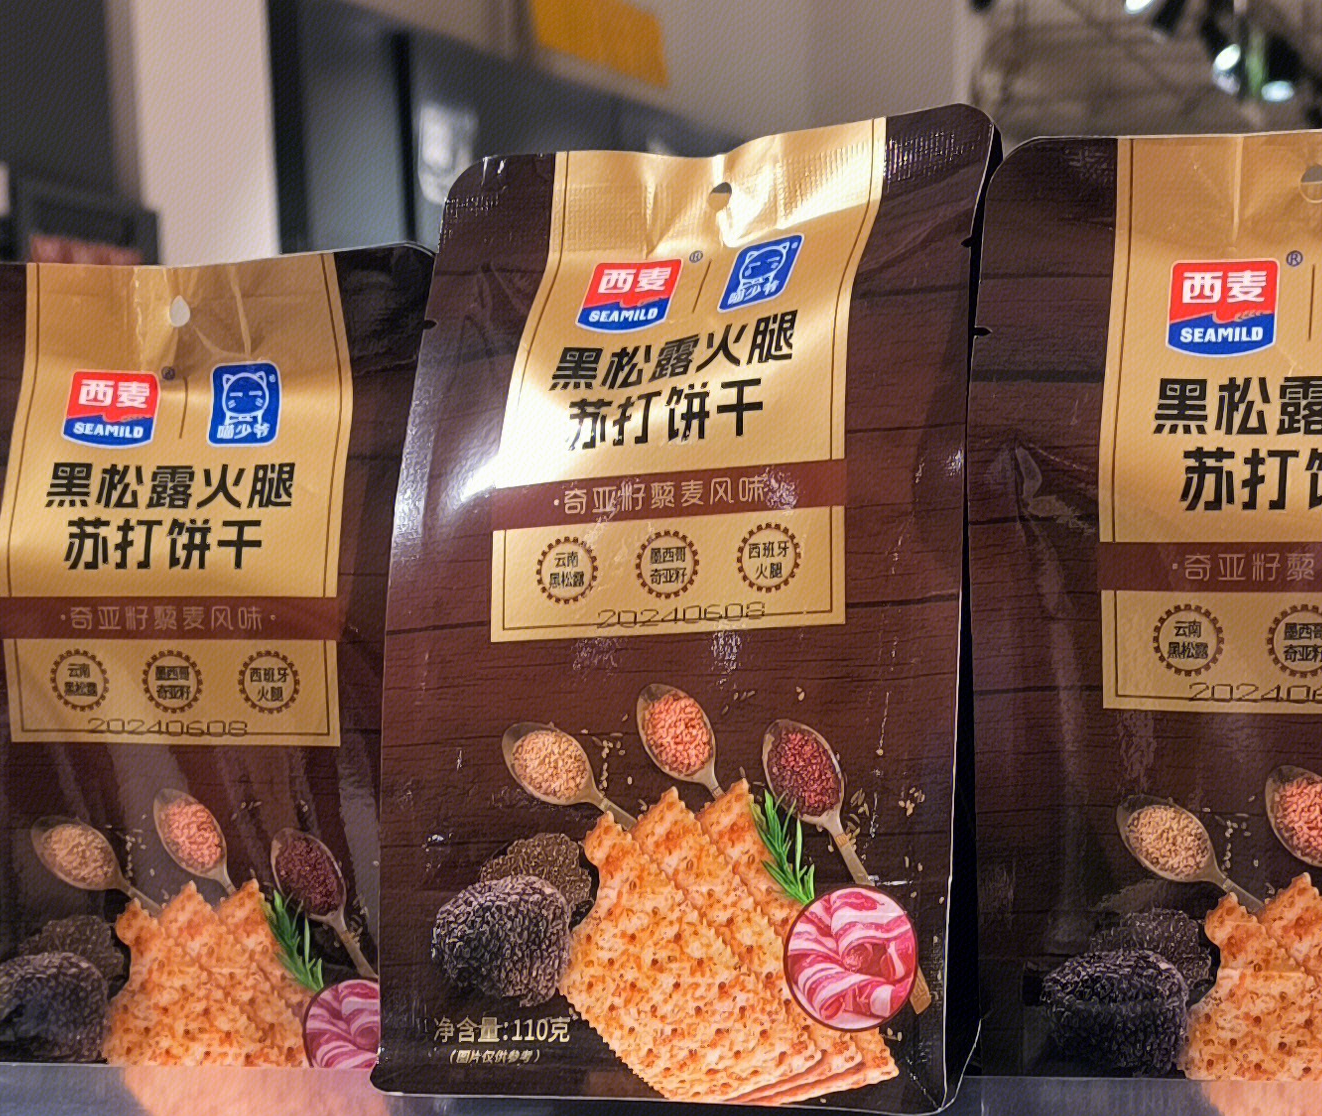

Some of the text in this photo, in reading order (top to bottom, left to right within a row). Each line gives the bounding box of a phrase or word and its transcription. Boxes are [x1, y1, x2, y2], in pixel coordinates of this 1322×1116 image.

[597, 268, 669, 295] 西麦
[1182, 270, 1267, 304] 西麦
[589, 307, 658, 324] SEAMILD
[1180, 325, 1264, 343] SEAMILD
[549, 310, 797, 390] 黑松露火腿
[78, 379, 151, 409] 西麦
[567, 377, 764, 451] 苏打饼干
[72, 422, 144, 439] SEAMILD
[44, 462, 296, 509] 黑松露火腿
[64, 517, 263, 570] 苏打饼干
[748, 540, 790, 560] 西班牙
[554, 551, 579, 568] 云南
[755, 561, 783, 580] 火腿
[597, 601, 766, 629] 20240608
[1174, 621, 1203, 639] 云南
[67, 662, 91, 680] 云南
[249, 667, 289, 684] 西班牙
[88, 717, 248, 737] 20240608
[434, 1016, 571, 1043] 净含量:110克
